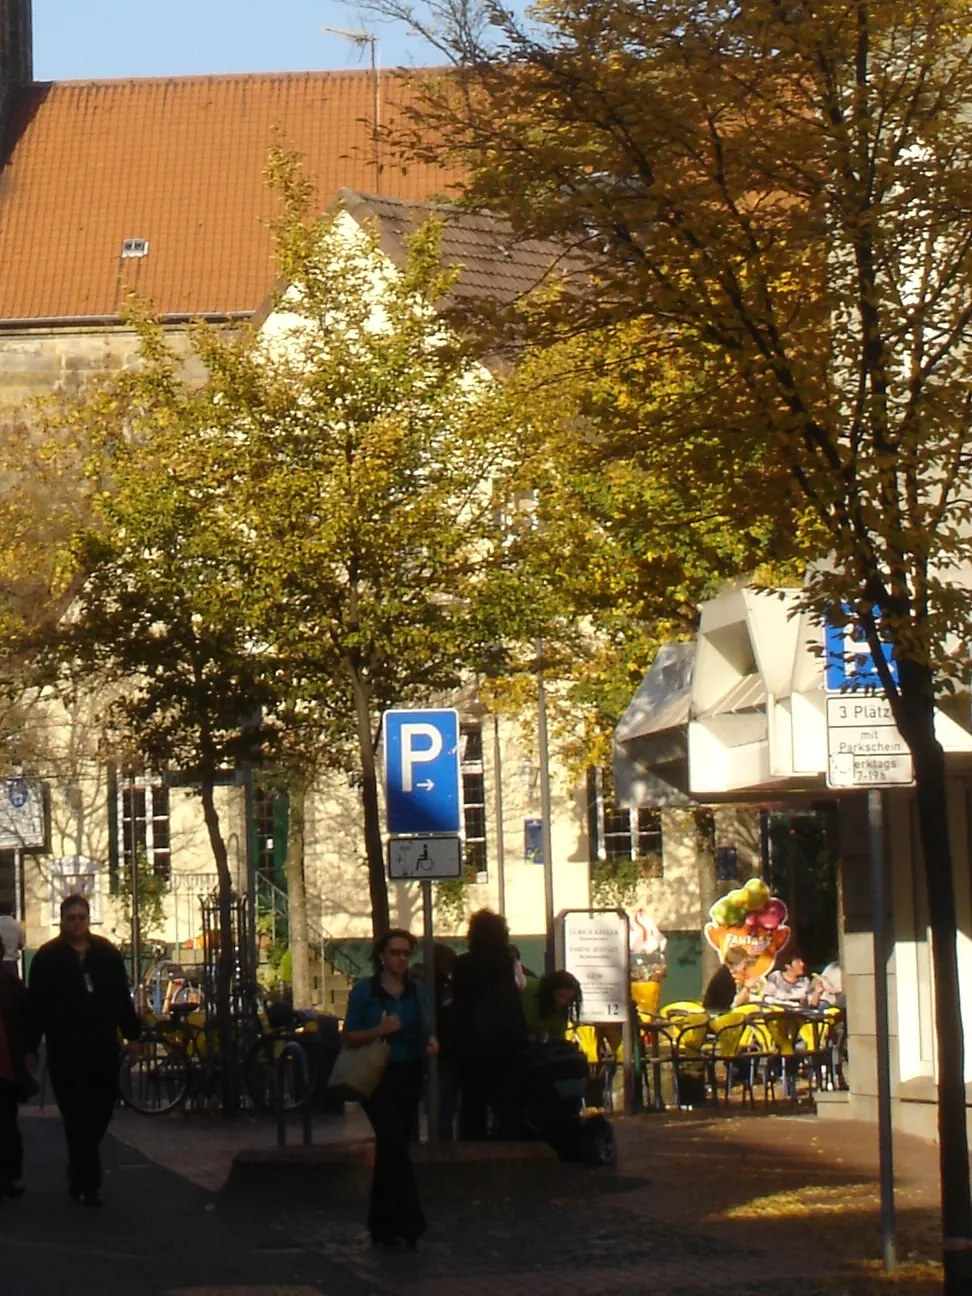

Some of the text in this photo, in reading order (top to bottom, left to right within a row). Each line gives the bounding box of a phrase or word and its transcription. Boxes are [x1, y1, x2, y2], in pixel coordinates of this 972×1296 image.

[839, 704, 890, 719] 3 Plätz
[860, 730, 879, 740] mit
[839, 741, 901, 752] Parkschein
[401, 723, 443, 792] P
[853, 759, 897, 771] erktags
[607, 1003, 619, 1015] 12
